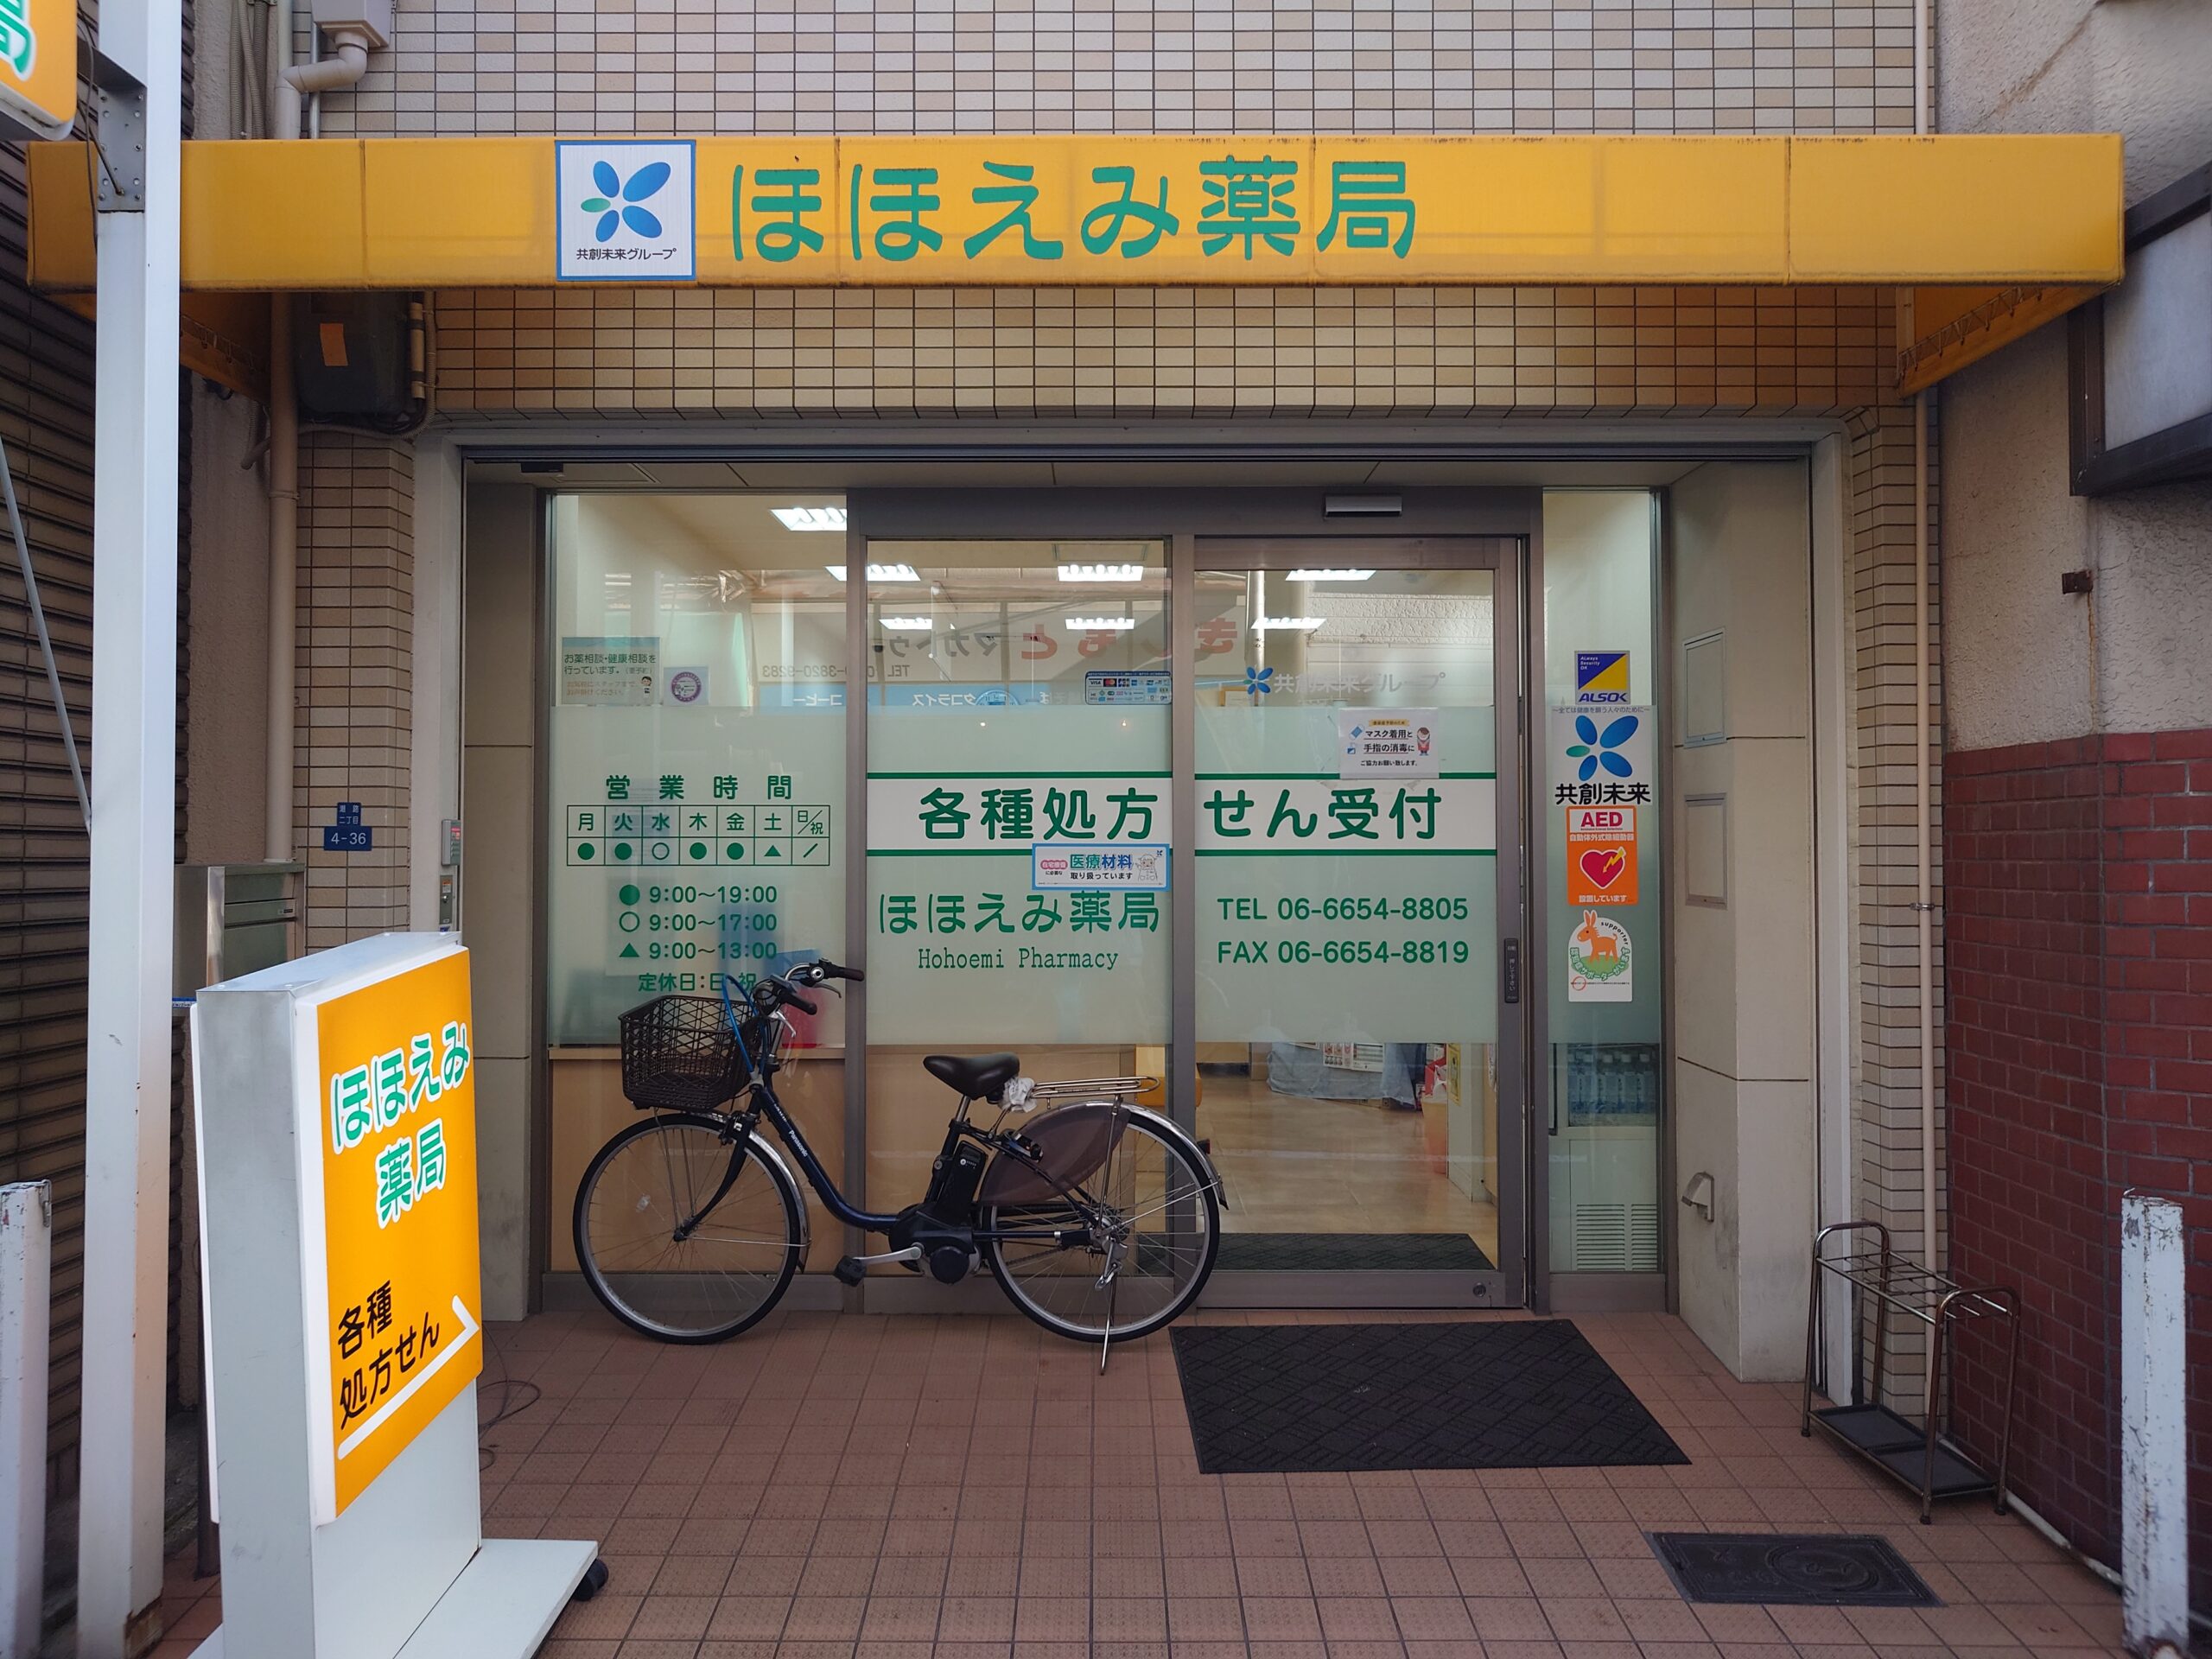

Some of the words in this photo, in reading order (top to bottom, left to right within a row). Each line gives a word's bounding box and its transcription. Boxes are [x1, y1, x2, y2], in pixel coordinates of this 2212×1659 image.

[733, 155, 1415, 262] ほほえみ薬局
[576, 248, 677, 261] 共創未来グループ
[564, 653, 658, 664] お薬相談・健康相談を
[564, 666, 620, 675] 行っています。
[1274, 672, 1446, 694] 共創未来グループ
[1579, 692, 1628, 702] ALSOK
[1365, 730, 1414, 739] マスク着用と
[1363, 743, 1415, 753] 手指の消毒に
[606, 775, 792, 800] 営業時間
[1555, 782, 1651, 805] 共創未来
[339, 816, 359, 824] 二丁目
[577, 813, 594, 831] 月
[613, 813, 633, 831] 火
[652, 813, 671, 831] 水
[689, 813, 708, 830] 木
[726, 813, 745, 831] 金
[763, 813, 783, 831] 土
[918, 787, 1159, 841] 各種処方
[1203, 787, 1442, 840] せん受付
[1580, 811, 1623, 828] AED
[331, 832, 367, 845] 4-36
[1070, 853, 1134, 870] 医療材料
[1070, 871, 1134, 880] 取り扱っています
[880, 891, 1160, 933] ほほえみ薬局
[1217, 898, 1268, 920] TEL
[1277, 898, 1469, 920] 06-6654-8805
[1600, 921, 1629, 945] supporter
[918, 948, 1005, 969] Hohoemi
[1019, 948, 1119, 970] Pharmacy
[1217, 940, 1268, 963] FAX
[1277, 940, 1470, 963] 06-6654-8819
[332, 1022, 471, 1153] ほほえみ
[788, 1129, 809, 1158] Panasonic
[377, 1120, 446, 1226] 薬局
[337, 1280, 393, 1361] 各種
[339, 1312, 441, 1431] 処方せん
